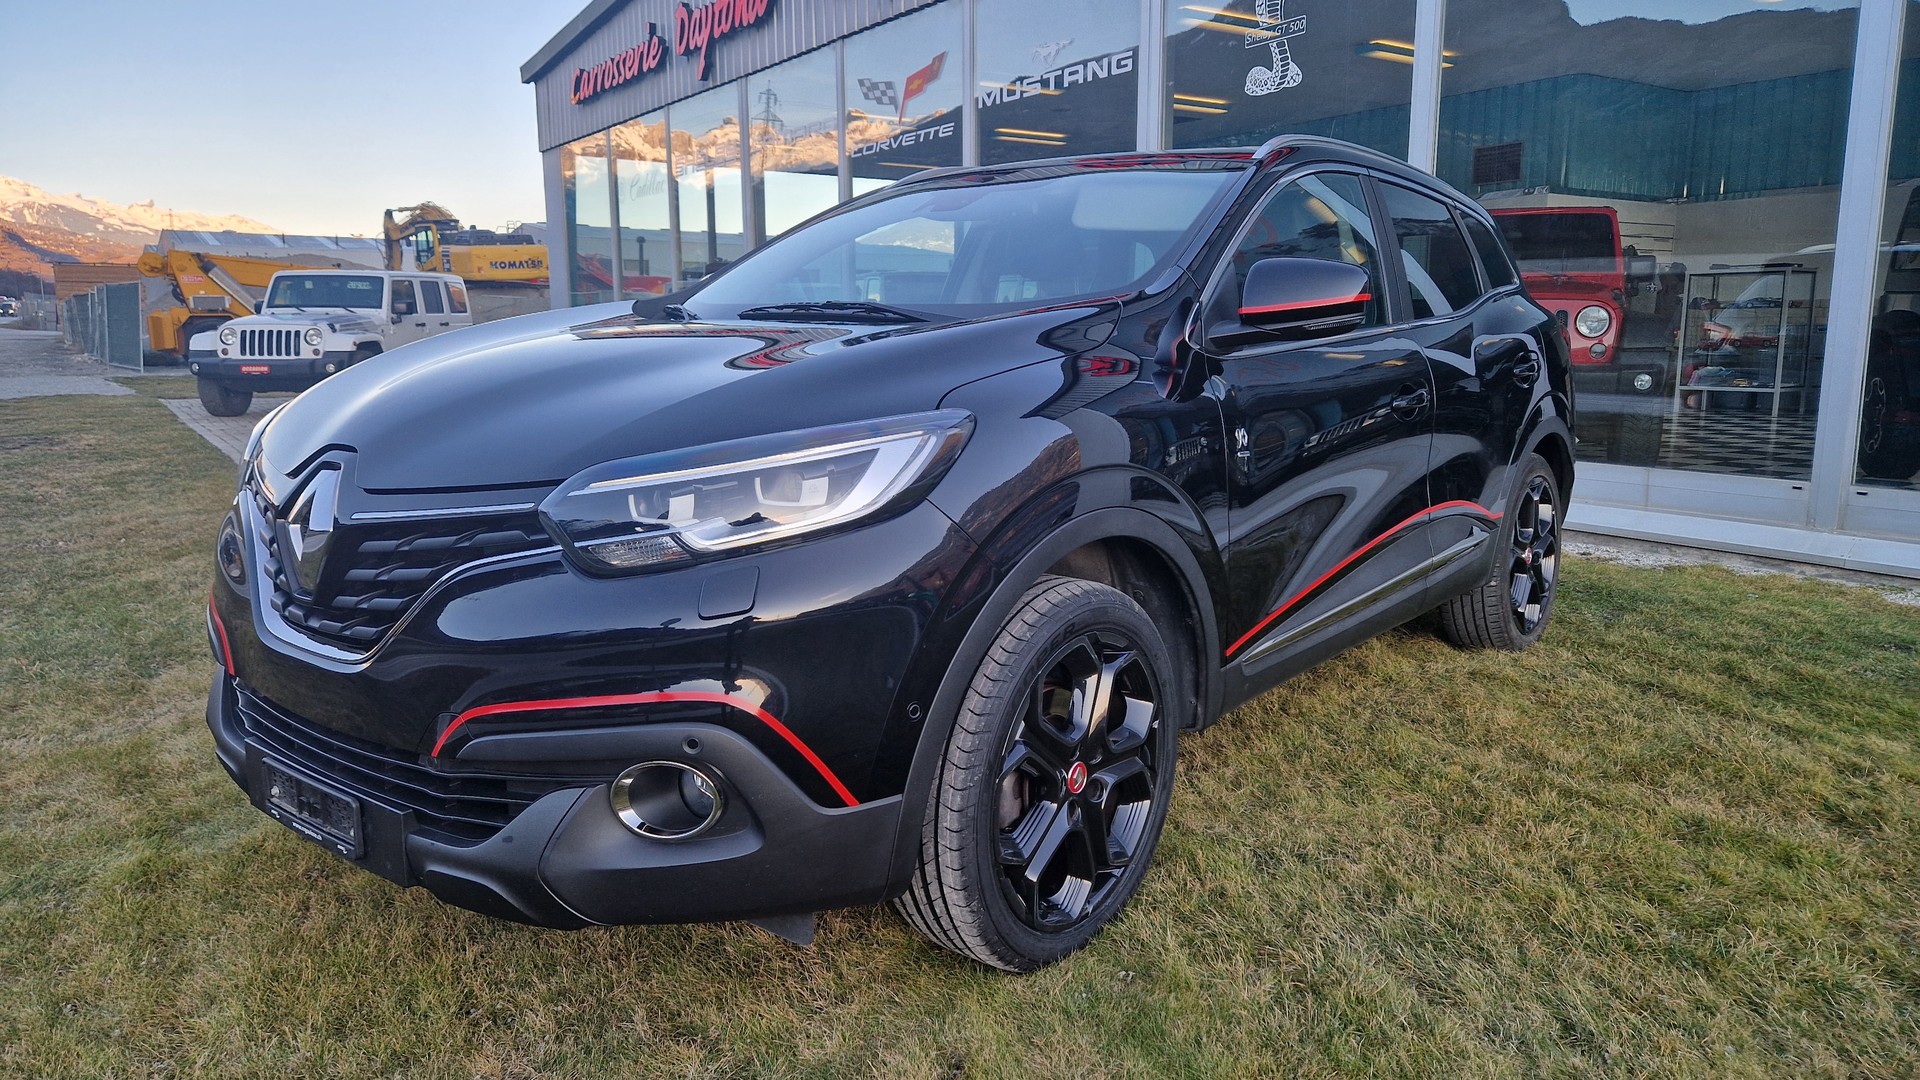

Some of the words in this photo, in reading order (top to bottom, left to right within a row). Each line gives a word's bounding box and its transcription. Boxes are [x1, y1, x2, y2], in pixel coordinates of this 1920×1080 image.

[1274, 24, 1288, 35] GT
[1289, 20, 1305, 33] 500
[571, 22, 664, 104] Carrosserie
[978, 51, 1133, 108] MUSTANG
[851, 123, 954, 158] CORVETTE
